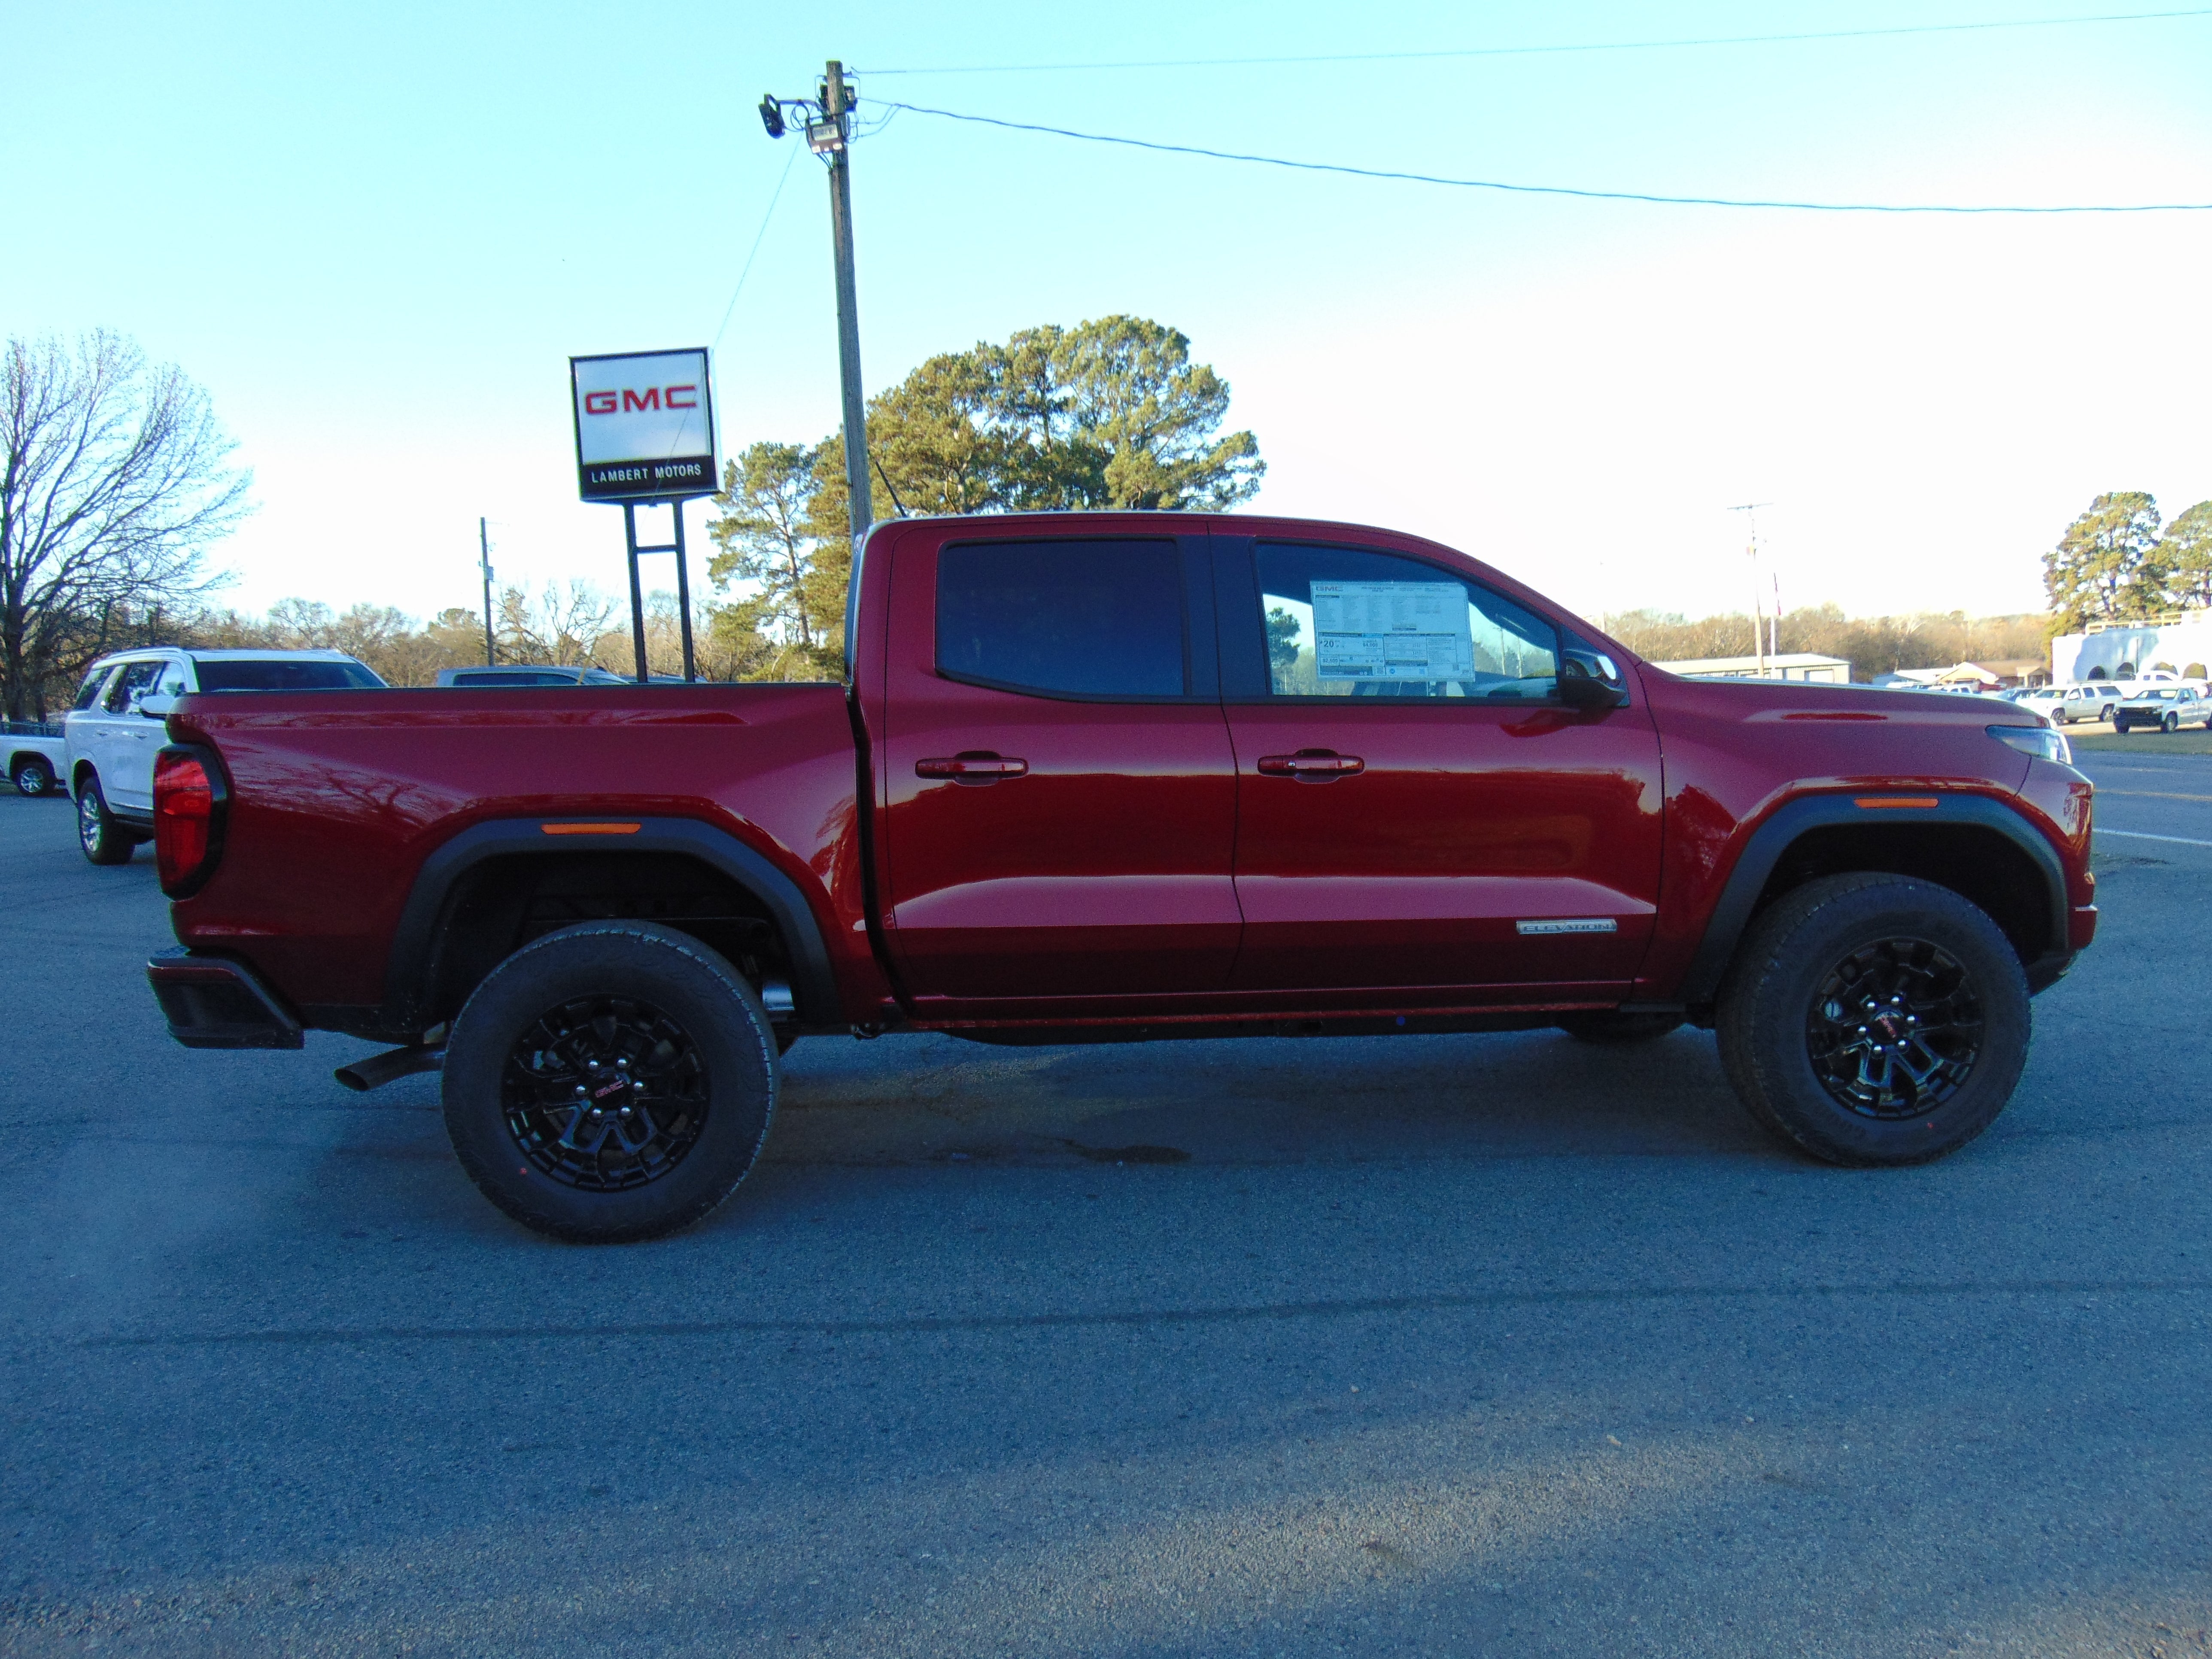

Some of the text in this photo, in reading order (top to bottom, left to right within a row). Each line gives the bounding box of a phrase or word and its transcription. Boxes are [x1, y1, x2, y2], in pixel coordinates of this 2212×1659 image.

[585, 385, 697, 415] GMC
[591, 463, 702, 483] LAMBERT MOTORS
[595, 1079, 624, 1098] GMC
